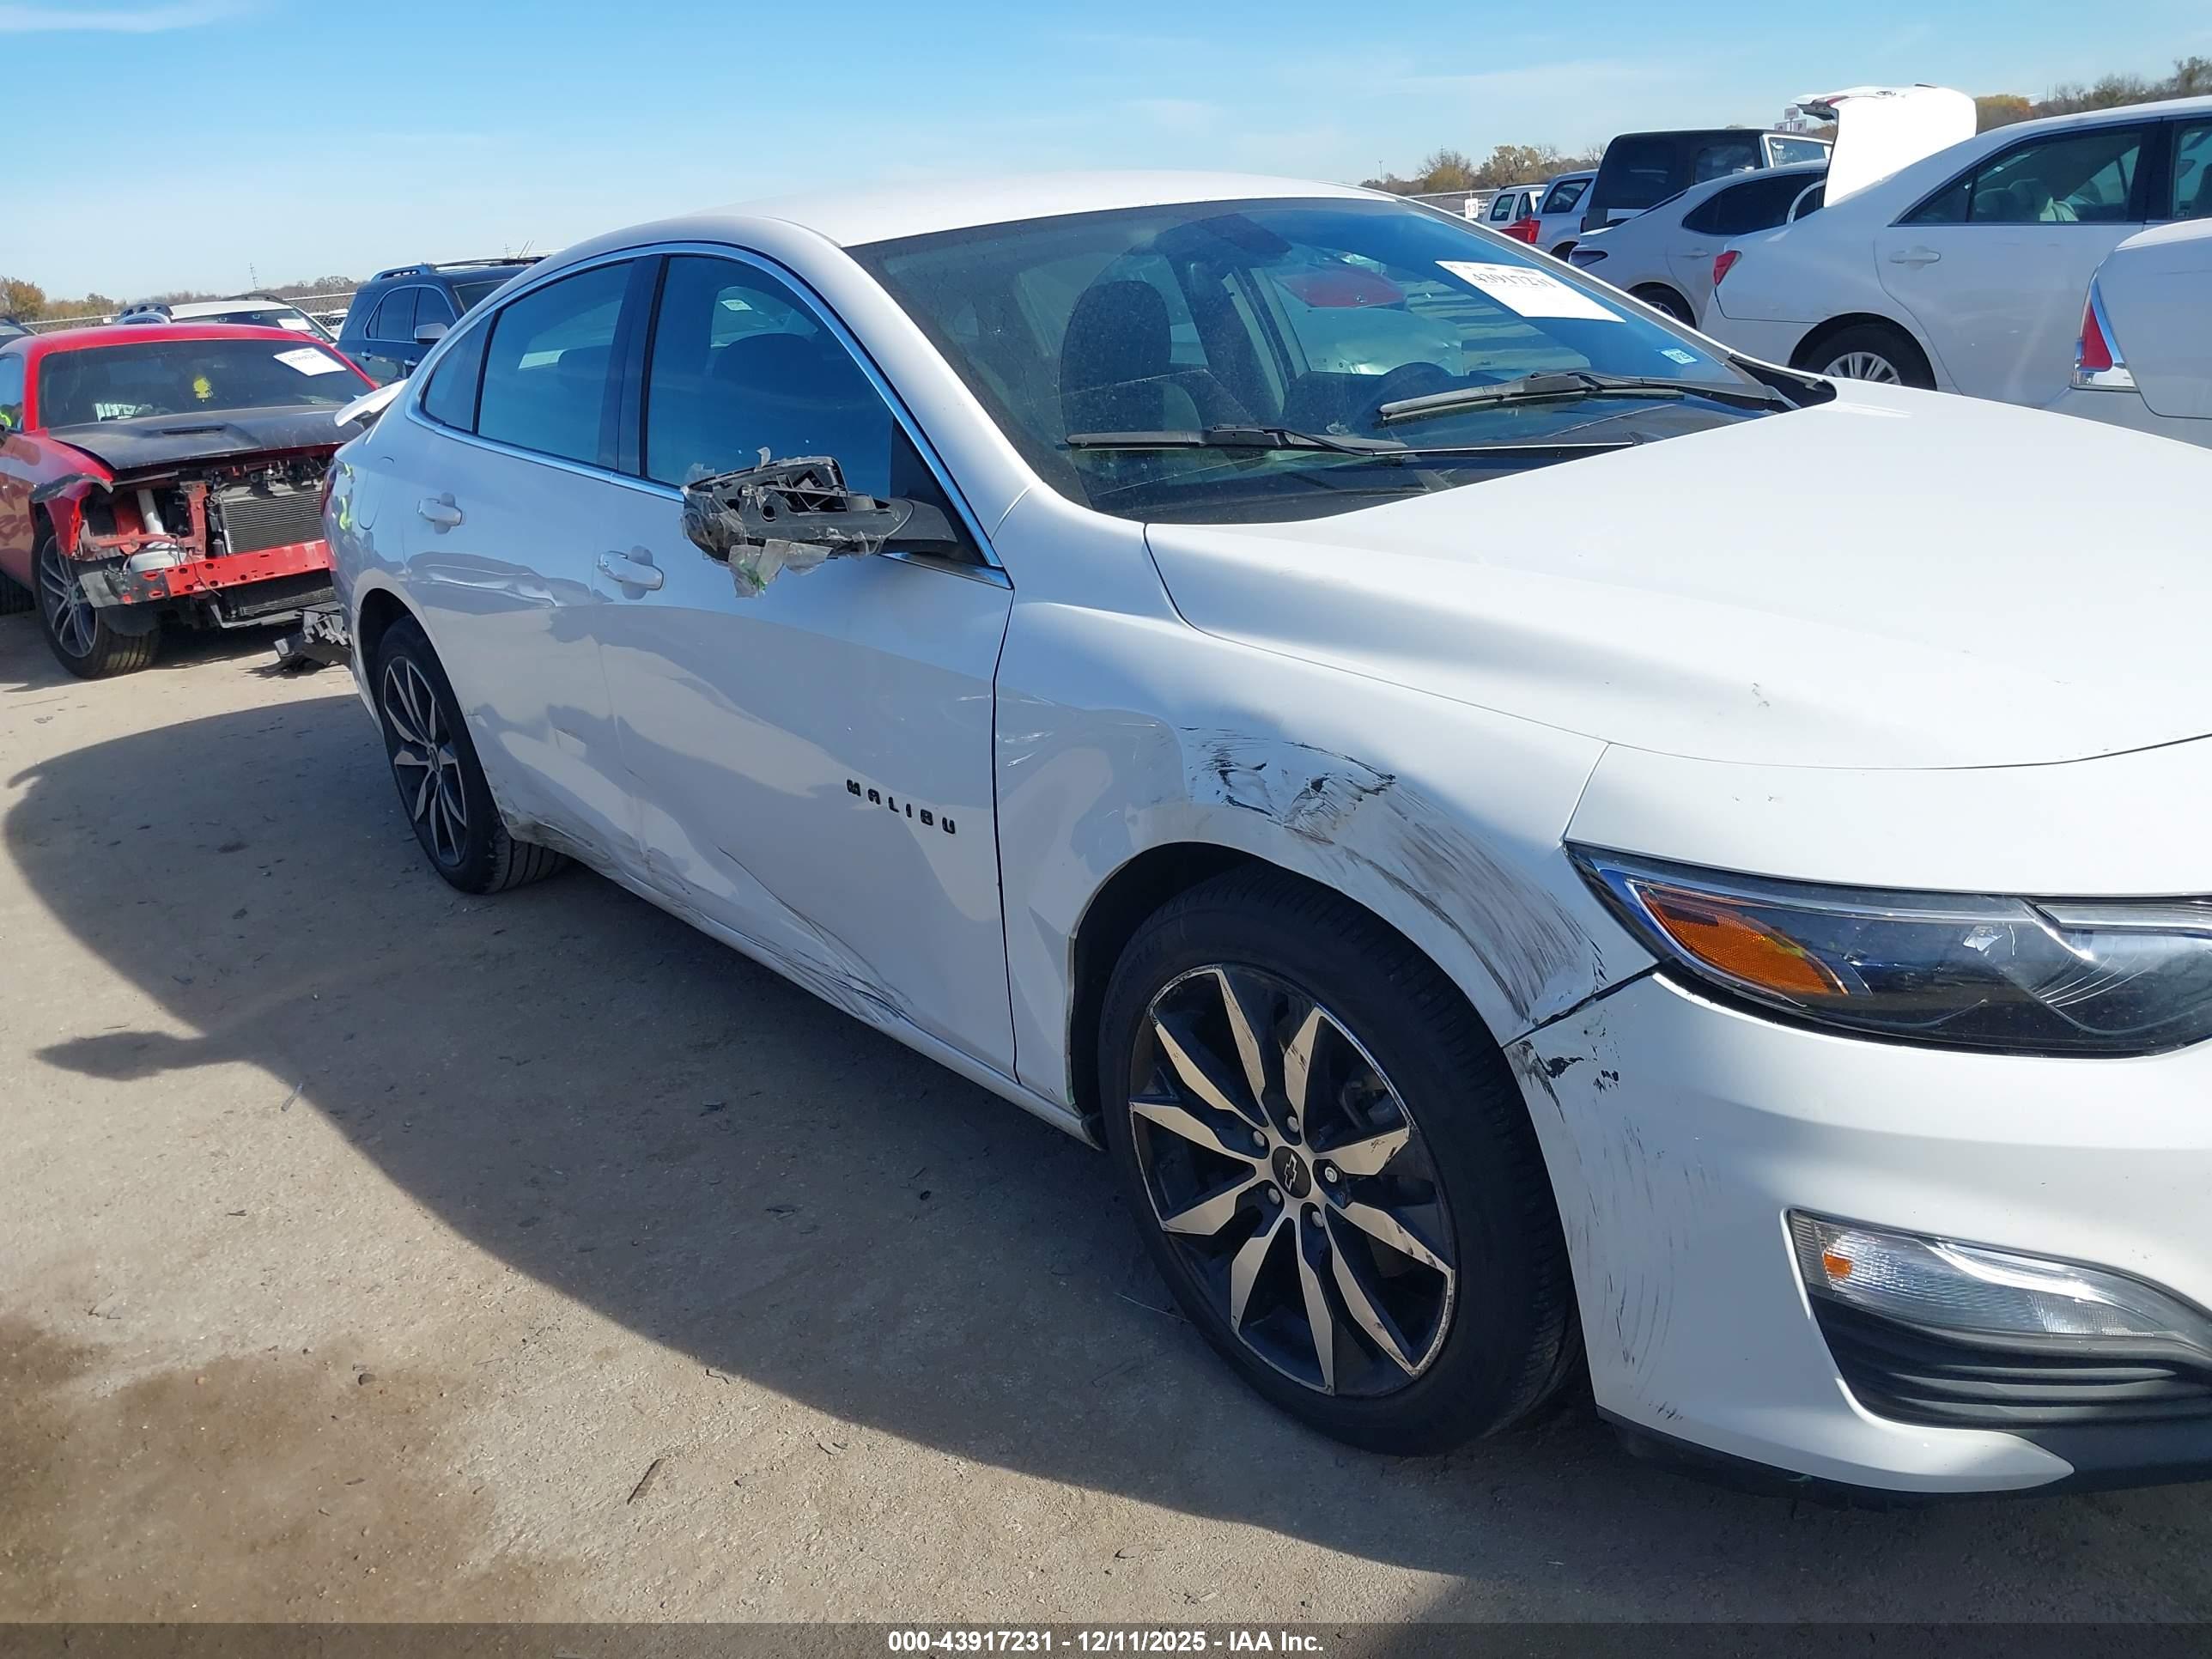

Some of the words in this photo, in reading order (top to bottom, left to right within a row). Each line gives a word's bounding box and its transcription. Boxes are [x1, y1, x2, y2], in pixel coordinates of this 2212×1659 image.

[1467, 204, 1477, 214] 13
[1472, 273, 1557, 289] 43917231
[846, 779, 956, 835] MALIBU
